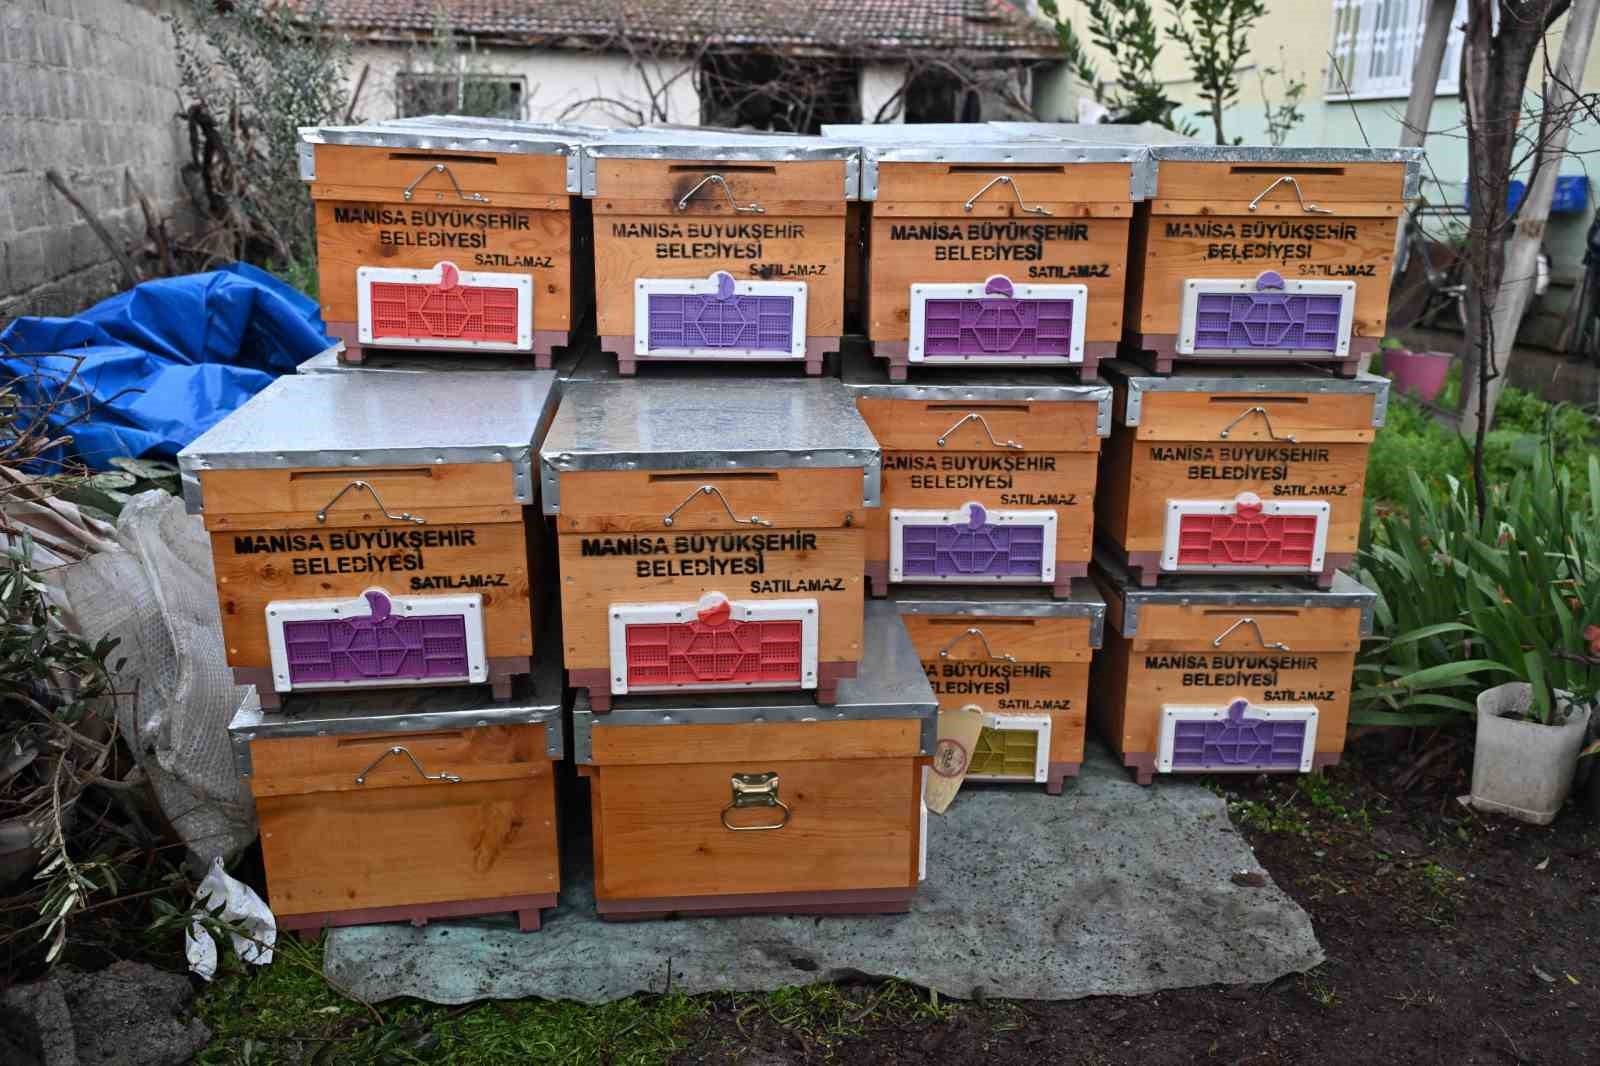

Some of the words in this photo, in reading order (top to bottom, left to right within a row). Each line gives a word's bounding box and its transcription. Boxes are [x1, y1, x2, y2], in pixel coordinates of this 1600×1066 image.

[380, 229, 487, 248] BELEDİYESİ
[891, 221, 964, 241] MANİSA
[967, 221, 1089, 243] BÜYÜKŞEHİR
[1165, 220, 1236, 239] MANİSA
[1240, 220, 1357, 241] BÜYÜKŞEHİR
[656, 240, 763, 259] BELEDİYESİ
[935, 242, 1043, 261] BELEDİYESİ
[475, 253, 555, 269] SATILAMAZ
[1028, 264, 1110, 279] SATILAMAZ
[1298, 264, 1377, 277] SATILAMAZ
[1150, 445, 1215, 462] MANİSA
[881, 455, 938, 472] ANİSA
[1188, 463, 1288, 481] BELEDİYESİ
[1273, 484, 1348, 497] SATILAMAZ
[1000, 493, 1078, 506] SATILAMAZ
[581, 534, 669, 557] MANİSA
[675, 530, 817, 555] BÜYÜKŞEHİR
[292, 551, 424, 576] BELEDİYESİ
[636, 553, 765, 578] BELEDİYESİ
[410, 573, 509, 590] SATILAMAZ
[750, 578, 846, 593] SATILAMAZ
[942, 661, 1053, 679] BÜYÜKŞEHİR
[1145, 654, 1208, 670] MANİSA
[929, 679, 1010, 695] LEDİYESİ
[1182, 671, 1278, 687] BELEDİYESİ
[1263, 689, 1335, 702] SATILAMAZ
[998, 699, 1072, 711] SATILAMAZ
